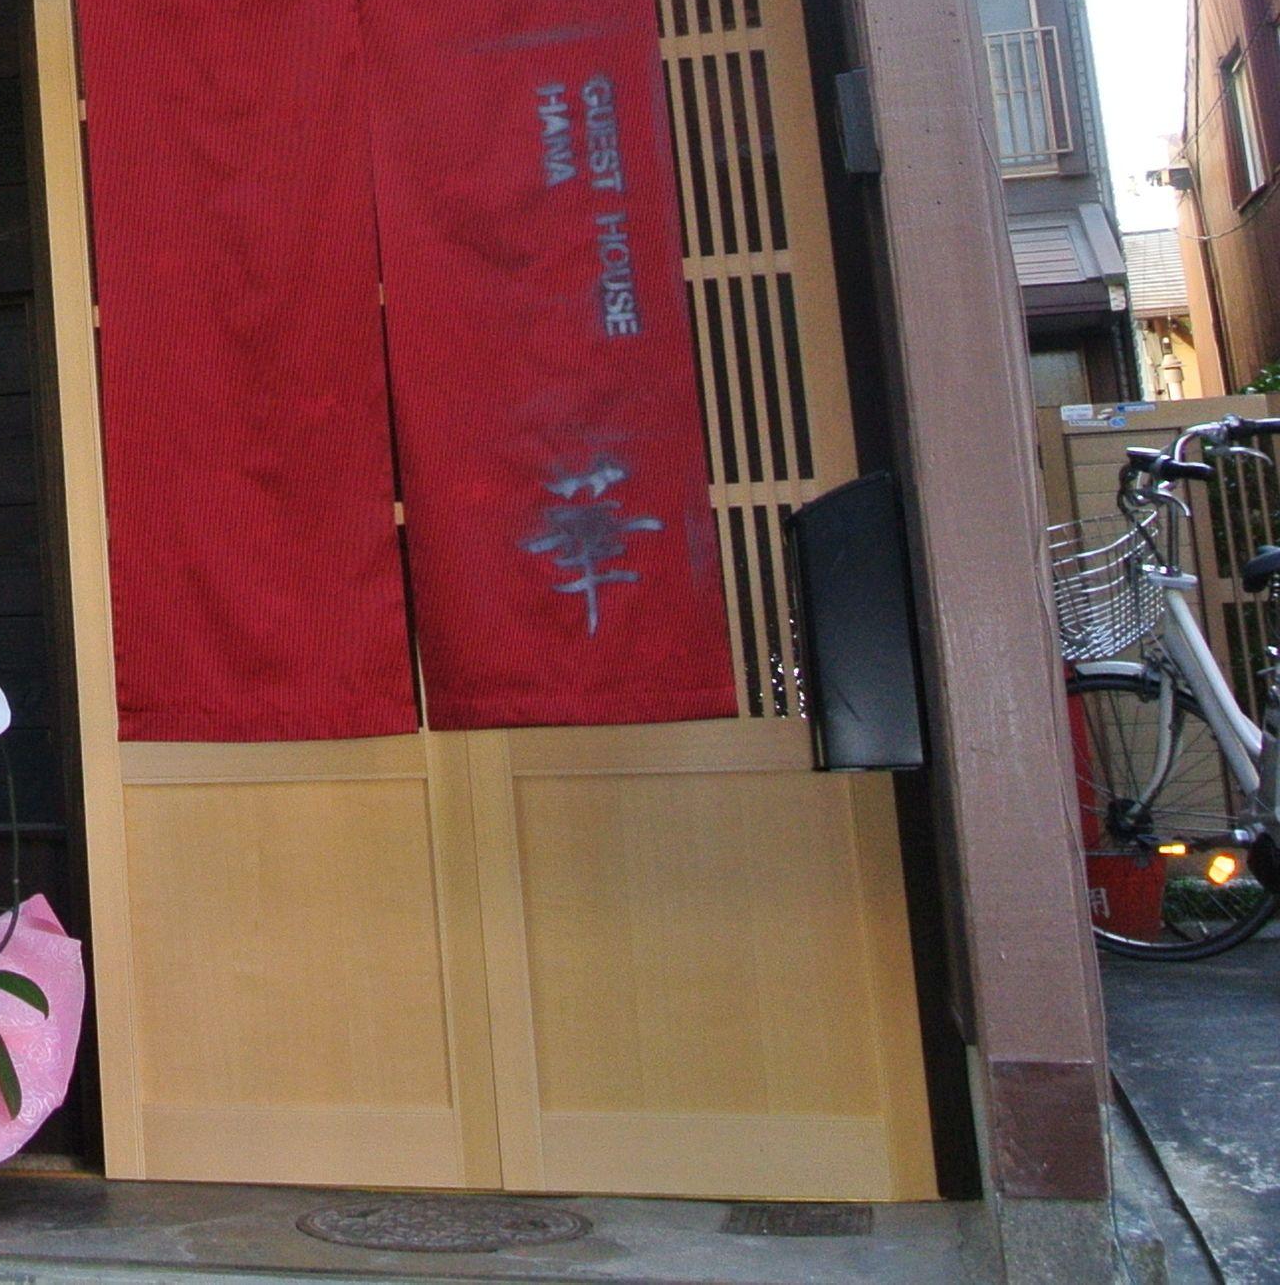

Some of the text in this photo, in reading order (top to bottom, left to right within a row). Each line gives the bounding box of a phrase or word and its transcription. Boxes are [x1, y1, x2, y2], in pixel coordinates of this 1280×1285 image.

[536, 81, 578, 188] HANA
[581, 75, 641, 338] GUEST HOUSE
